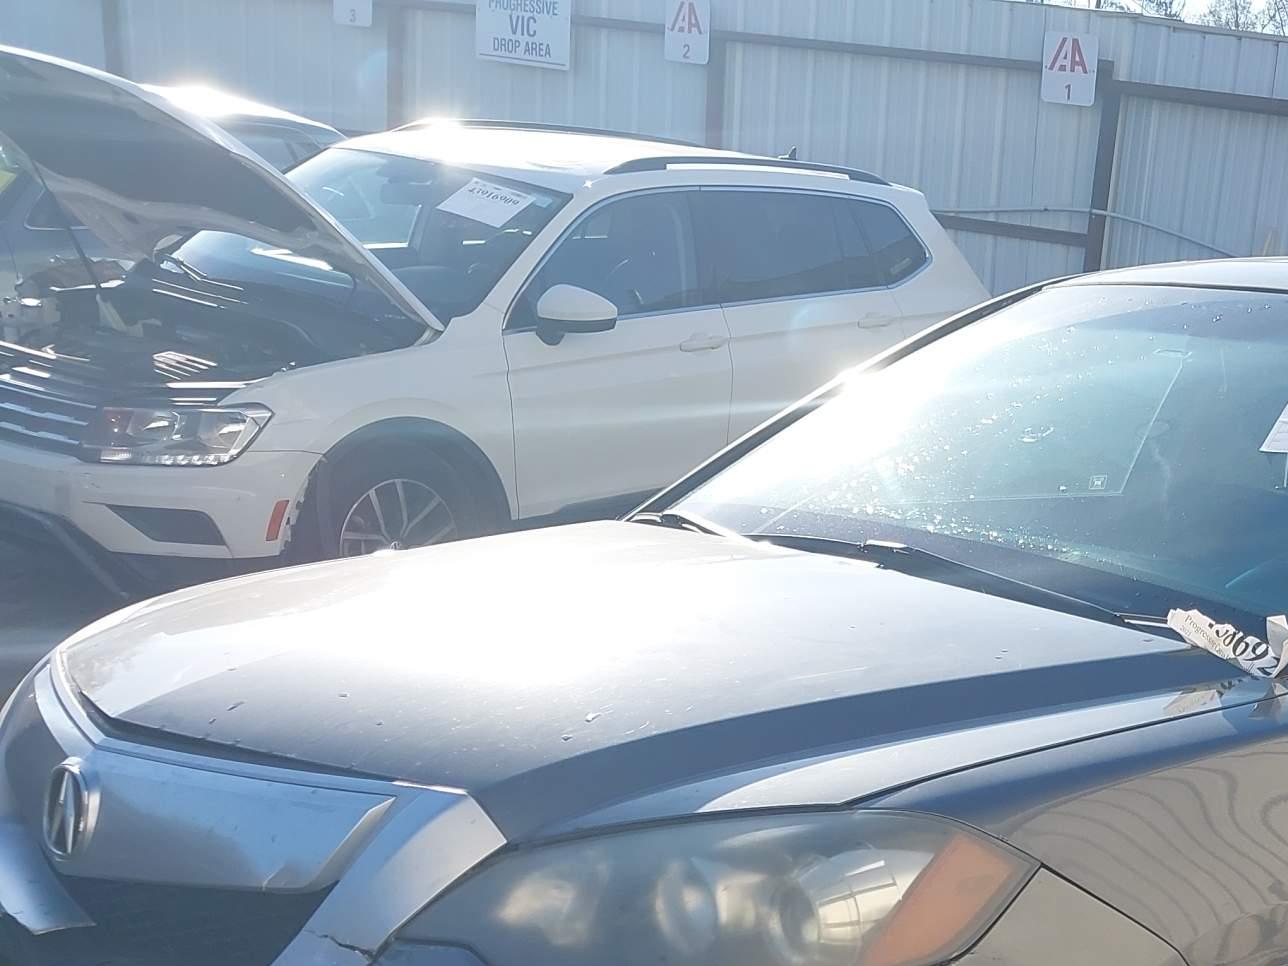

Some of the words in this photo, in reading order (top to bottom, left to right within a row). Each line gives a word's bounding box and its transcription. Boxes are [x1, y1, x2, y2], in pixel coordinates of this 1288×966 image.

[349, 9, 357, 23] 3
[488, 0, 559, 16] PROGRESSIVE
[509, 14, 537, 37] VIC
[492, 37, 521, 53] DROP
[523, 41, 552, 58] AREA
[682, 44, 690, 59] 2
[1065, 84, 1072, 100] 1
